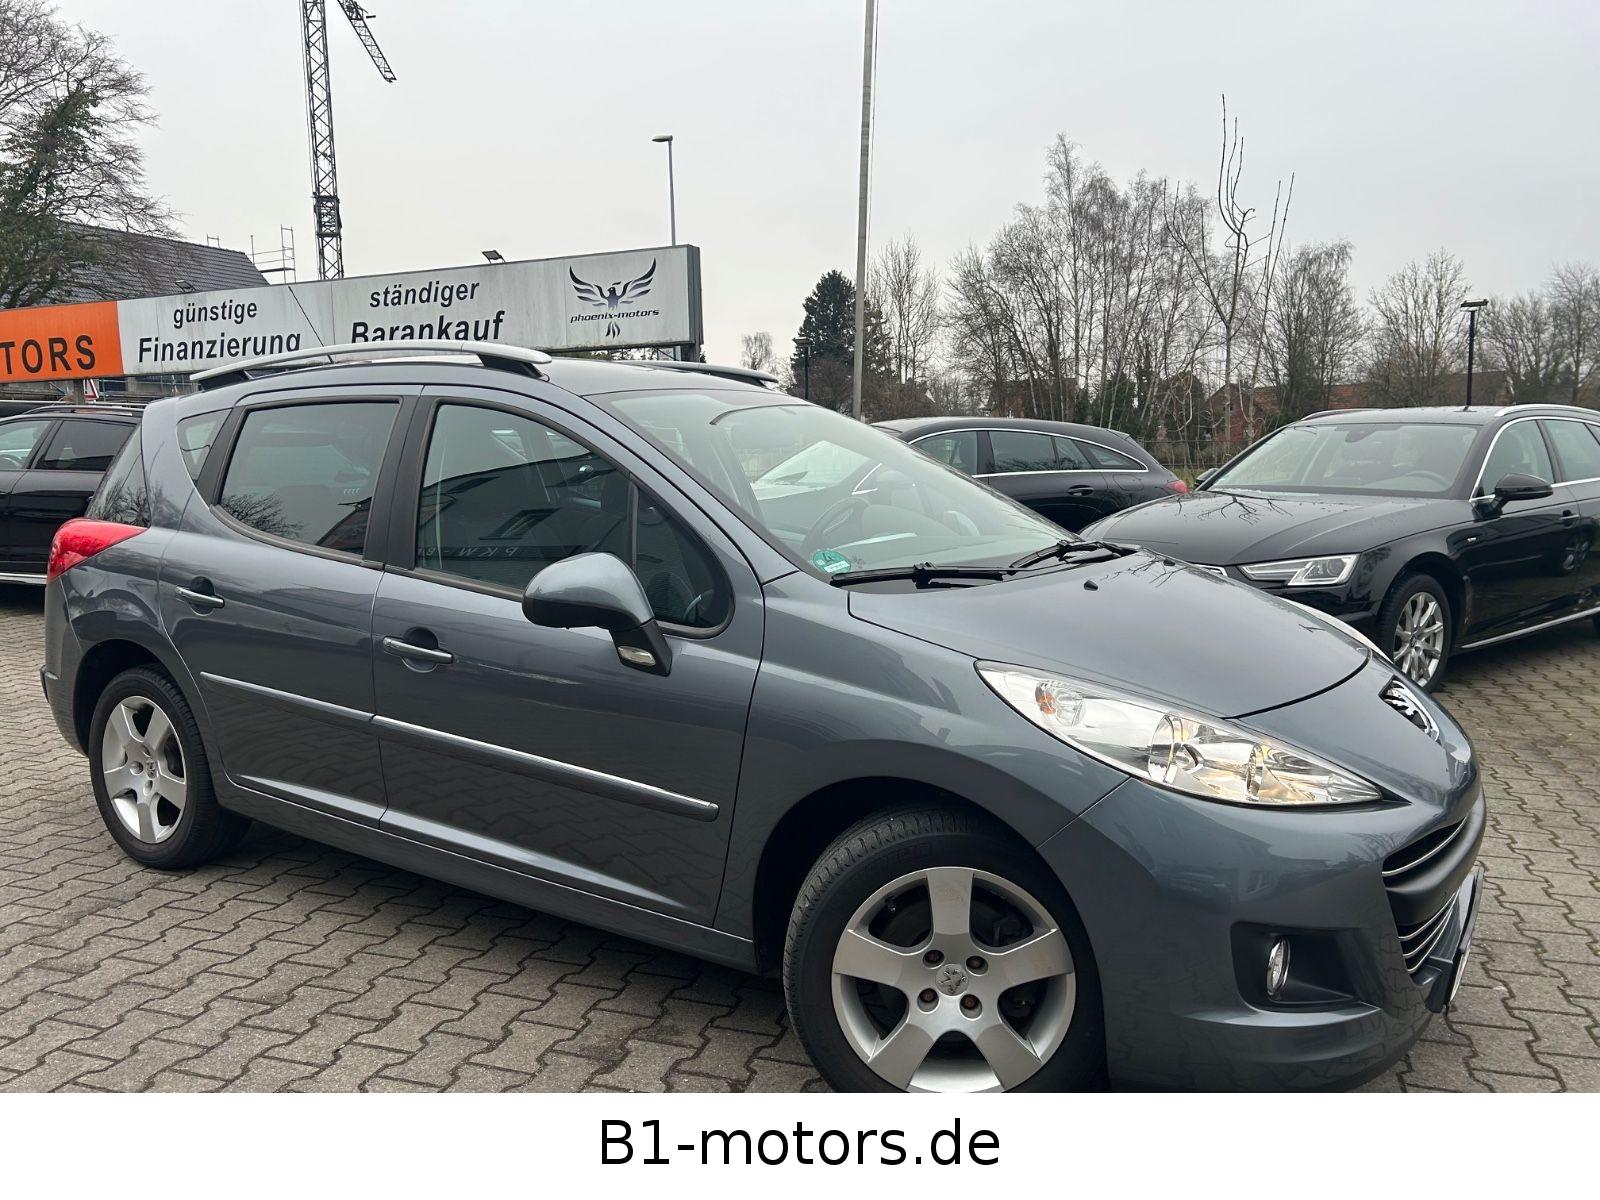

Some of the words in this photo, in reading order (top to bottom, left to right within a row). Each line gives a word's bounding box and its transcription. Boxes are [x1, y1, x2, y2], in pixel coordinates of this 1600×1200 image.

[369, 280, 480, 308] ständiger
[173, 299, 258, 329] günstige
[351, 310, 505, 344] Barankauf
[569, 308, 661, 324] phoenix-motors
[0, 334, 96, 375] TORS
[138, 332, 301, 363] Finanzierung
